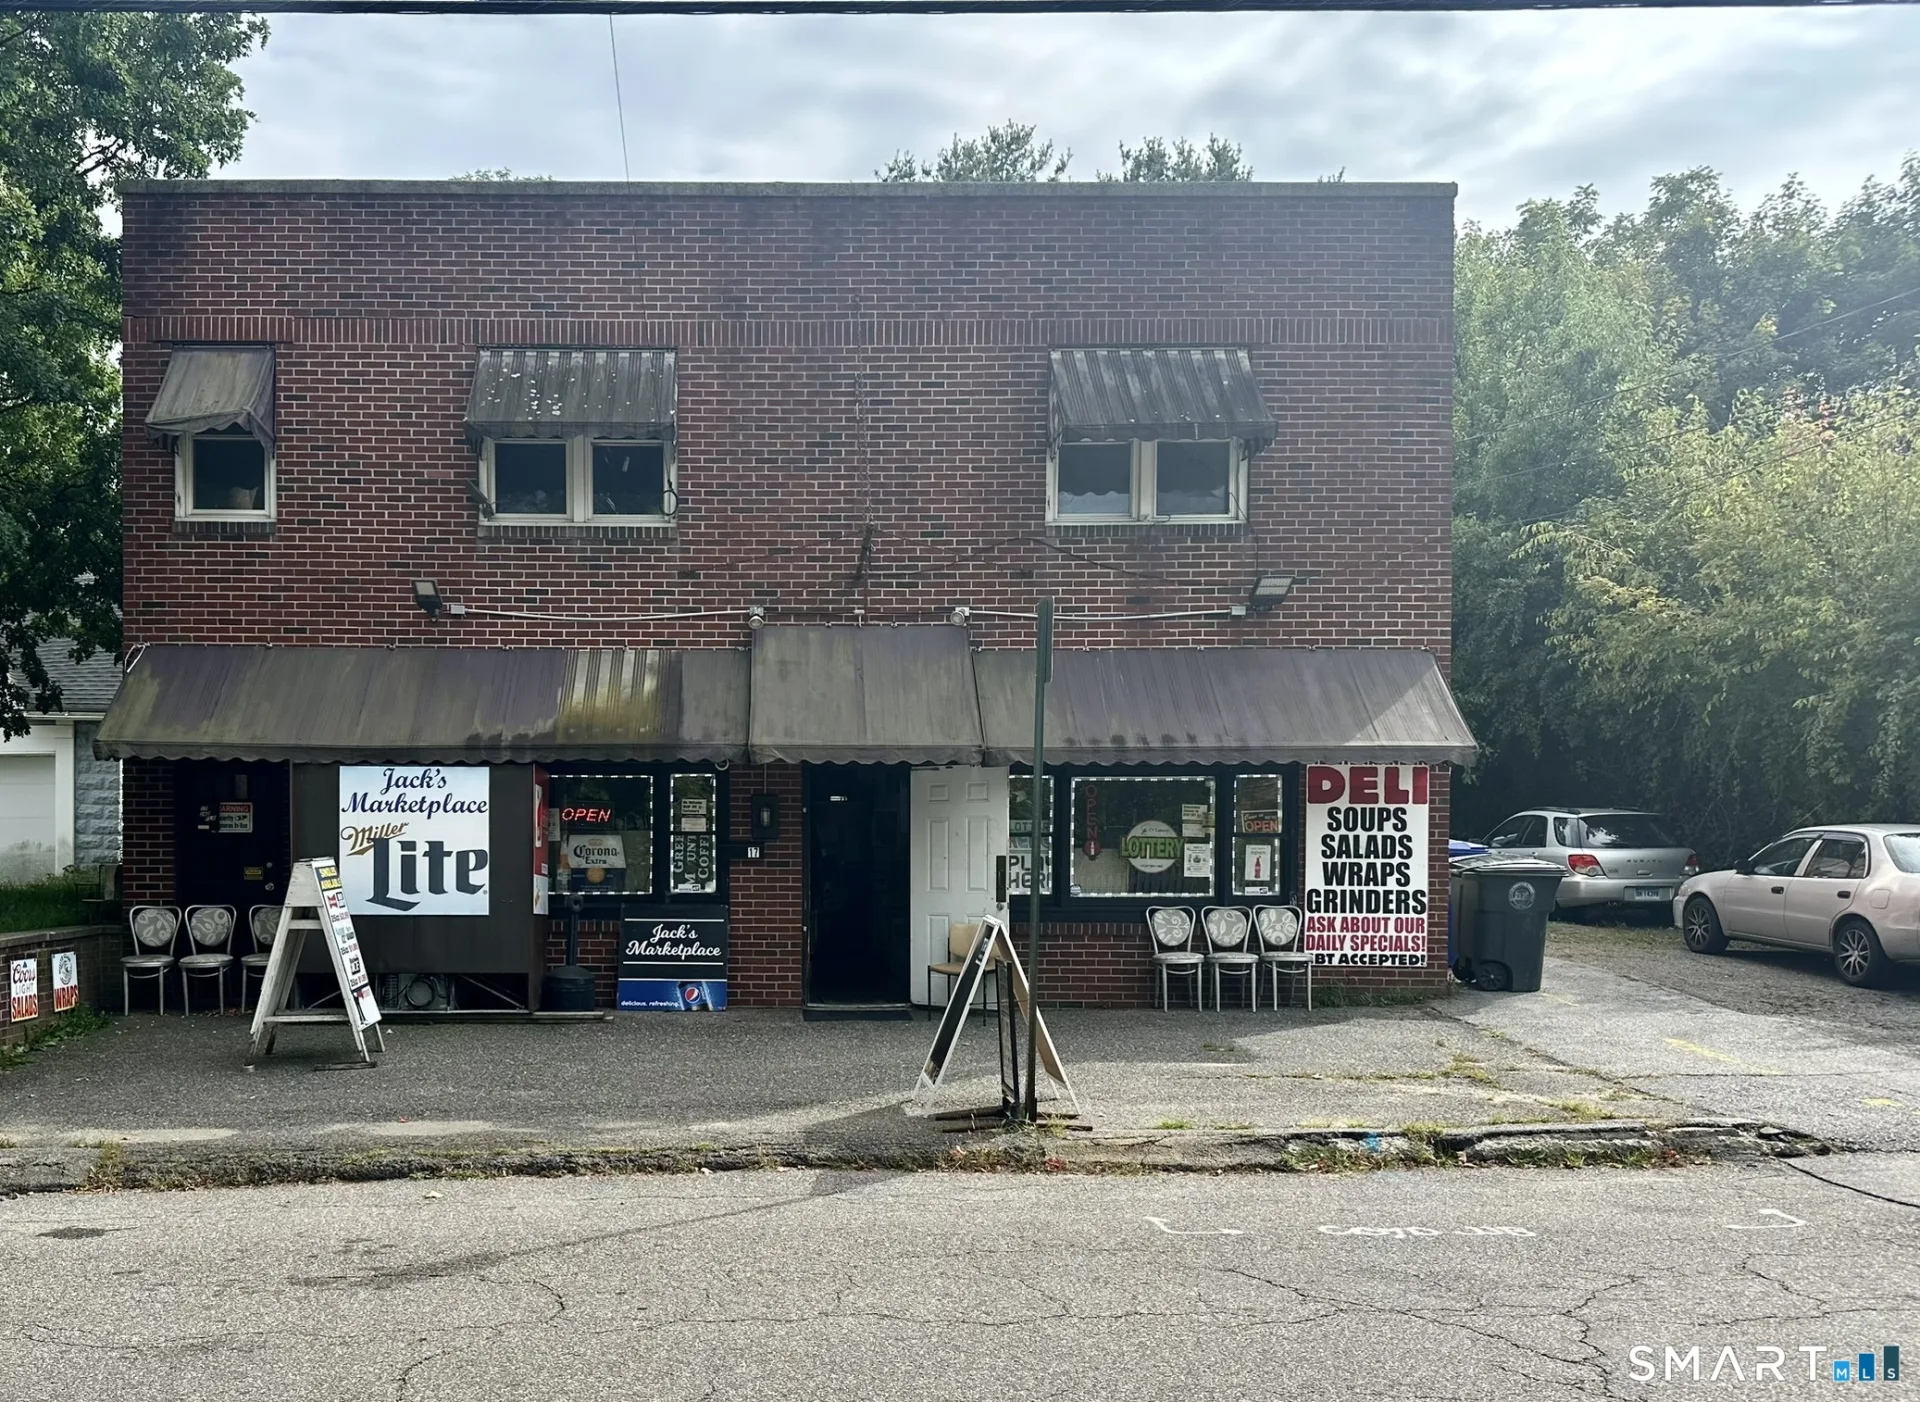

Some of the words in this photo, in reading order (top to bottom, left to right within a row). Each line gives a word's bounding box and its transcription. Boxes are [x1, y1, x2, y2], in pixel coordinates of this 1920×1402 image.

[380, 767, 447, 796] Jack's
[1307, 766, 1429, 804] DELI
[341, 792, 489, 820] Marketplace
[561, 807, 612, 823] OPEN
[1085, 784, 1098, 841] OPEN
[1245, 820, 1278, 831] OPEN
[1326, 807, 1408, 832] SOUPS
[340, 822, 410, 852] Miller
[1120, 836, 1184, 859] LOTTERY
[1321, 834, 1413, 859] SALADS
[573, 844, 616, 859] Corona
[585, 856, 607, 865] Extra
[748, 847, 759, 858] 17
[365, 838, 488, 911] Lite
[1322, 862, 1411, 887] WRAPS
[1306, 889, 1427, 915] GRINDERS
[649, 923, 698, 943] Jack's
[1306, 916, 1336, 933] ASK
[1340, 916, 1390, 934] ABOUT
[1394, 917, 1425, 934] OUR
[625, 940, 722, 960] Marketplace
[1305, 935, 1347, 952] DAILY
[1350, 935, 1427, 952] SPECIALS!
[1310, 953, 1334, 966] BT
[1337, 953, 1426, 966] ACCEPTED!
[12, 964, 36, 984] Coors
[15, 983, 34, 995] LIGHT
[54, 985, 79, 1010] WRAPS
[12, 994, 38, 1020] SALADS
